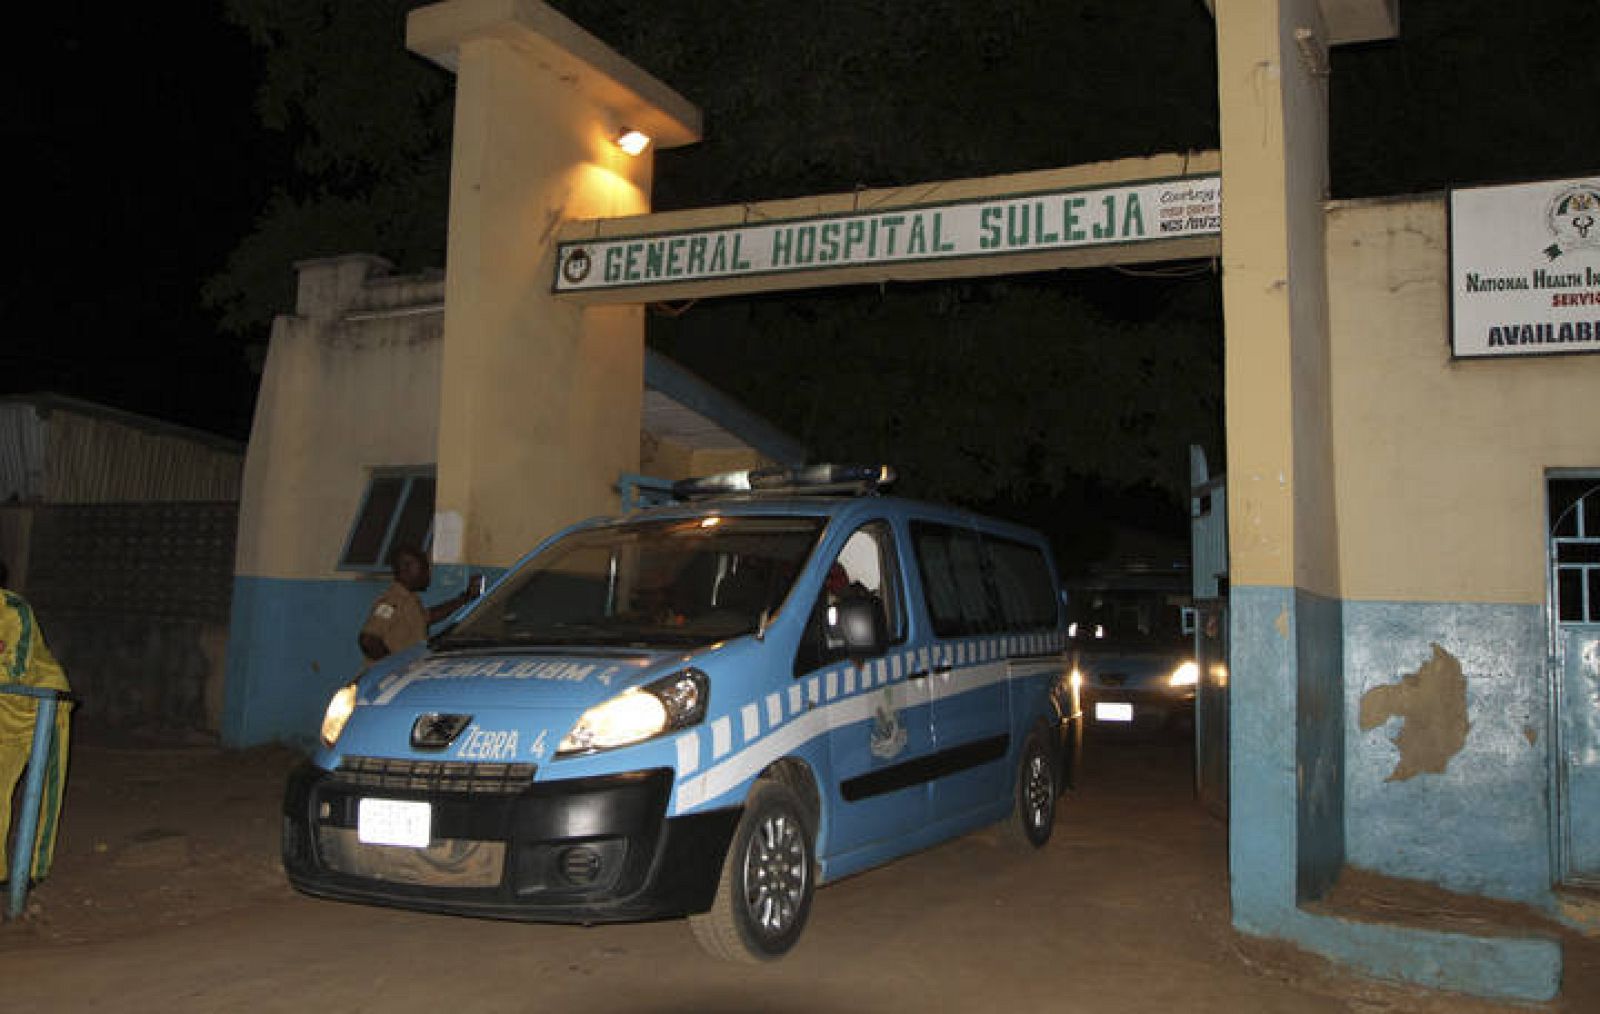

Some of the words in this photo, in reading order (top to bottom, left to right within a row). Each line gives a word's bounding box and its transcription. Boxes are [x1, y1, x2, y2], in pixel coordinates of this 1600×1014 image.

[603, 232, 750, 283] GENERAL
[771, 211, 954, 268] HOSPITAL
[979, 192, 1145, 248] SULEJA
[456, 724, 519, 759] ZEBRA
[530, 728, 548, 760] 4
